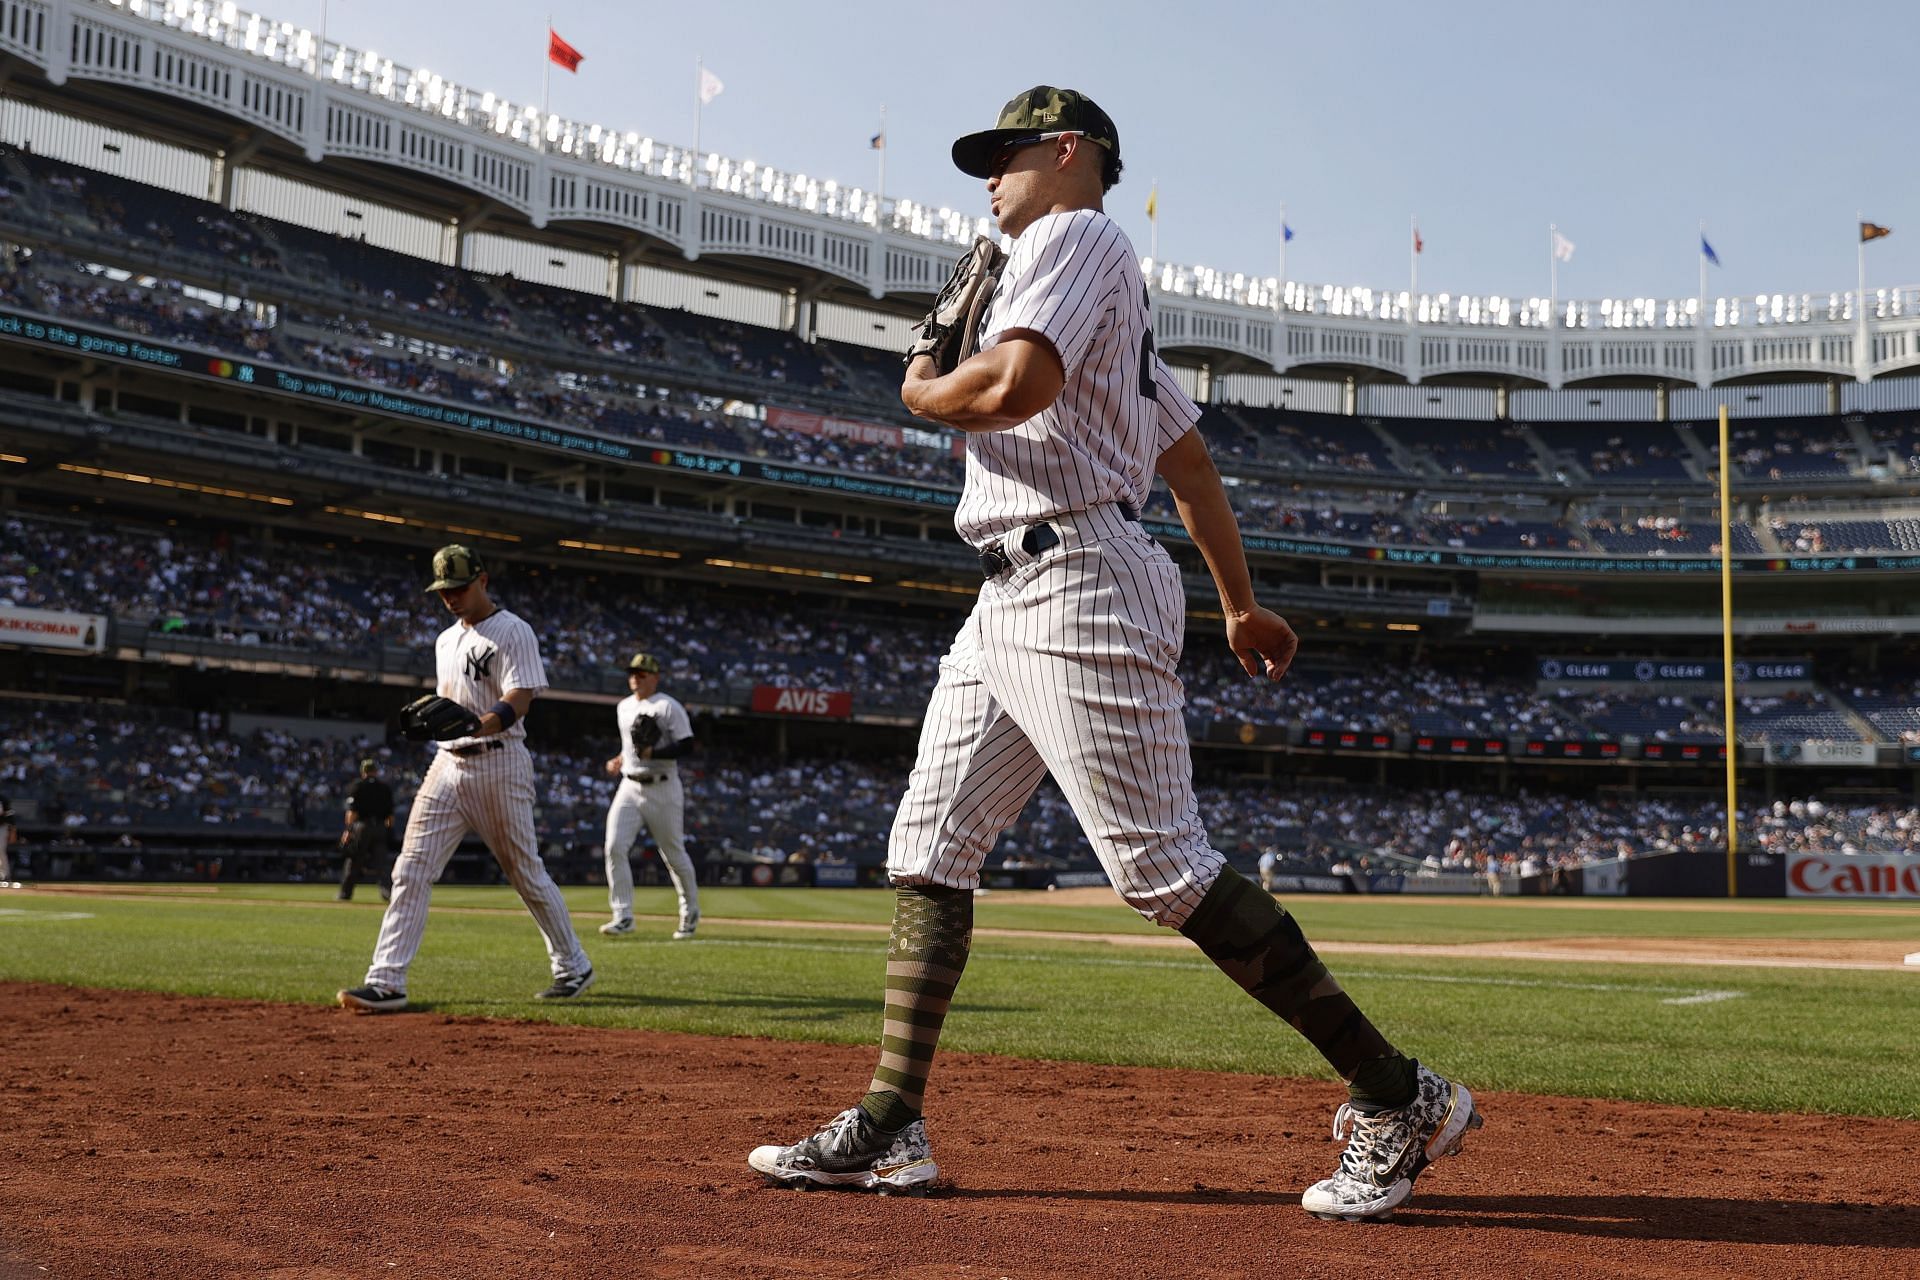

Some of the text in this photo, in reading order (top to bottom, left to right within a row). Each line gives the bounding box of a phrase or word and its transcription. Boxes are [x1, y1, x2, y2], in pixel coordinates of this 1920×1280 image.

[25, 321, 46, 339] to
[48, 326, 78, 346] the
[80, 334, 128, 356] game
[276, 371, 304, 393] Tap
[305, 380, 336, 399] with
[336, 386, 368, 403] your
[368, 390, 443, 420] Mastercard
[443, 408, 469, 426] and
[469, 414, 492, 433] get
[493, 419, 522, 436] back
[523, 425, 538, 440] to
[540, 429, 560, 445] the
[561, 434, 594, 451] game
[675, 451, 696, 470] Tap
[761, 463, 780, 481] Tap
[782, 470, 807, 485] with
[808, 473, 832, 489] your
[1387, 548, 1402, 563] Tap
[1456, 553, 1473, 567] Tap
[464, 644, 497, 682] NY
[1566, 664, 1611, 678] CLEAR
[1660, 665, 1705, 679] CLEAR
[1756, 664, 1805, 678] CLEAR
[774, 690, 830, 714] AVIS
